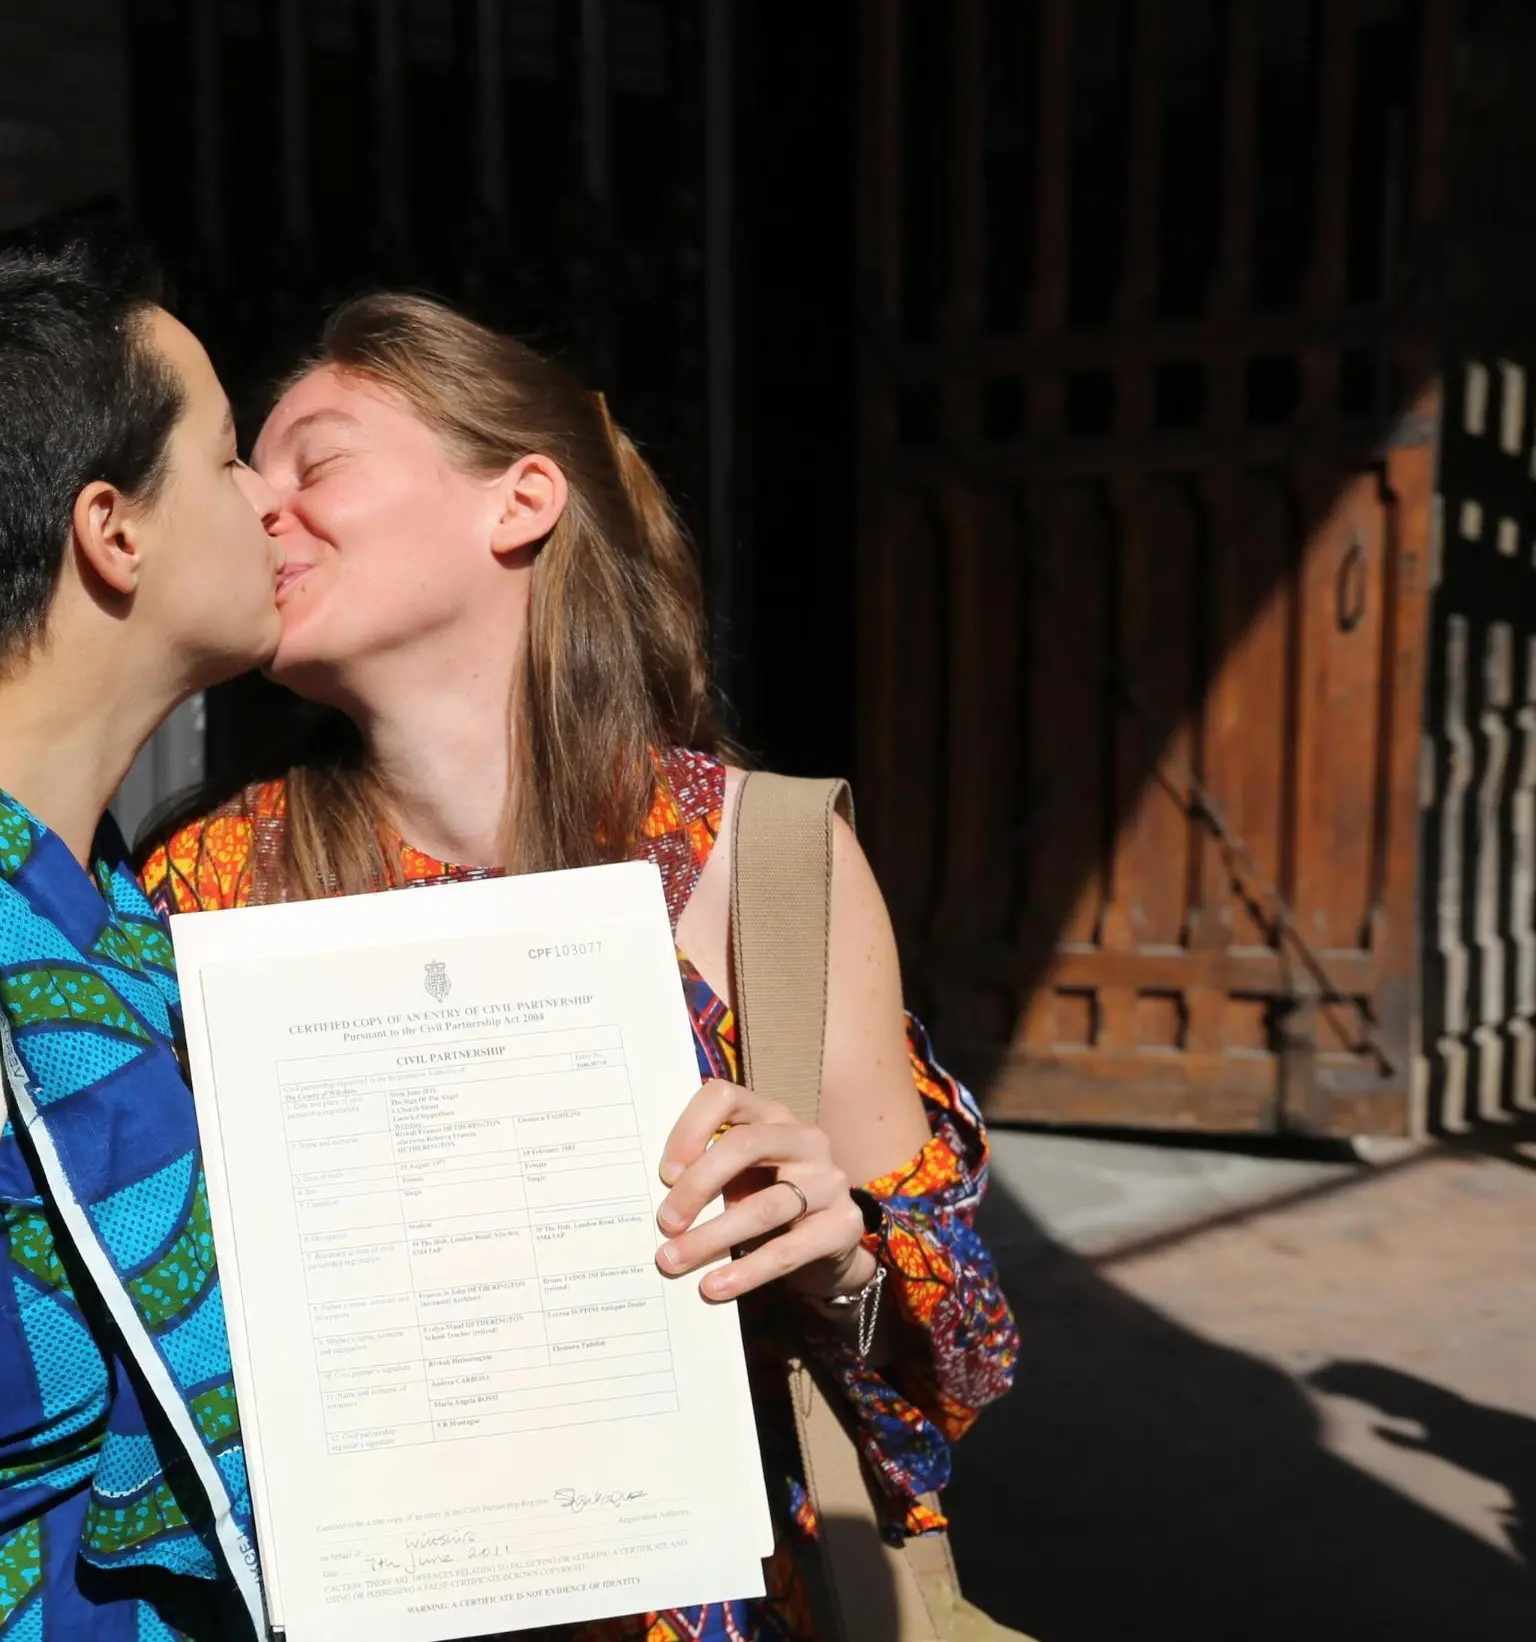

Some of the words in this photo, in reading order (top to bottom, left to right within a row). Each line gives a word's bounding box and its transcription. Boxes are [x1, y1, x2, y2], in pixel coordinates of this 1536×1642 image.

[287, 1020, 350, 1034] CERTIFIED
[352, 1016, 383, 1027] COPY
[385, 1014, 402, 1024] OF
[406, 1012, 422, 1021] AN
[422, 1008, 460, 1020] ENTRY
[463, 1006, 480, 1015] OF
[482, 1003, 512, 1013] CIVIL
[516, 994, 594, 1010] PARTNERSHIP
[342, 1029, 386, 1041] Pursuant
[388, 1027, 400, 1036] to
[400, 1026, 417, 1035] the
[418, 1023, 443, 1033] Civil
[444, 1017, 501, 1032] Partnership
[503, 1015, 519, 1024] Act
[521, 1012, 544, 1022] 2004
[395, 1054, 427, 1066] CIVIL
[429, 1046, 505, 1062] PARTNERSHIP
[402, 1547, 454, 1574] June
[451, 1600, 458, 1608] A
[459, 1593, 513, 1607] CERTIFICATE
[516, 1592, 524, 1600] IS
[526, 1589, 543, 1598] NOT
[545, 1584, 586, 1596] EVIDENCE
[588, 1582, 600, 1590] OF
[600, 1577, 641, 1589] IDENTITY
